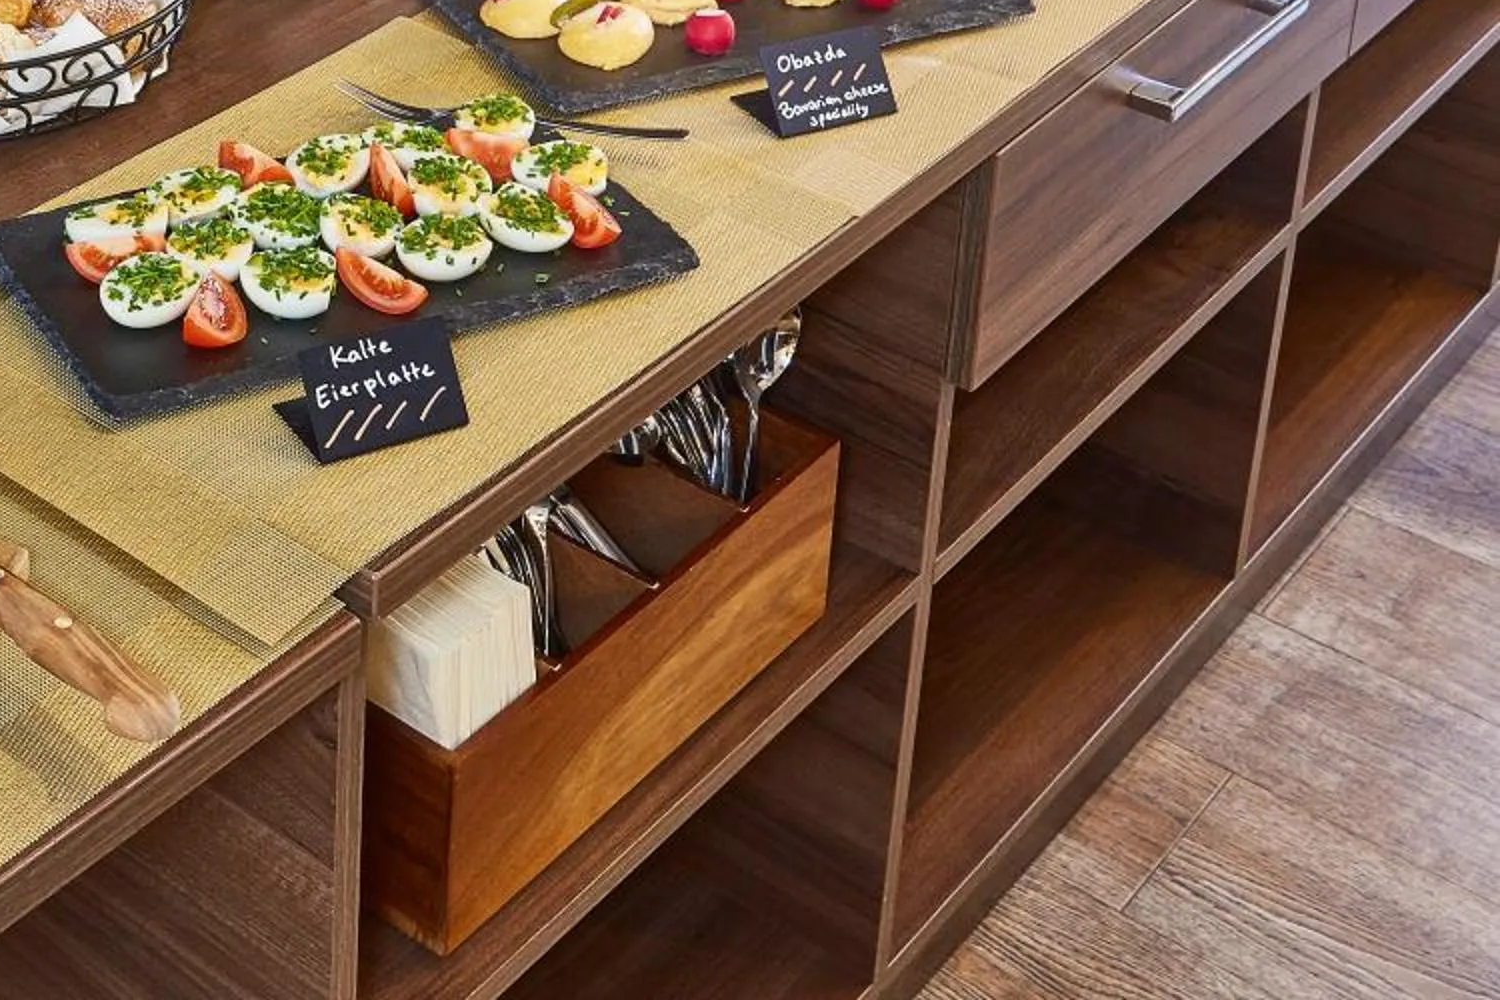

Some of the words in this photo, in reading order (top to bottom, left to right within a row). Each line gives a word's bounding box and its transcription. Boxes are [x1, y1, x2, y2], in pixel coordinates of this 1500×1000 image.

[777, 94, 842, 120] Bavarian
[844, 82, 889, 101] cheese
[329, 337, 393, 369] Kalte
[314, 361, 436, 409] Eierplatte
